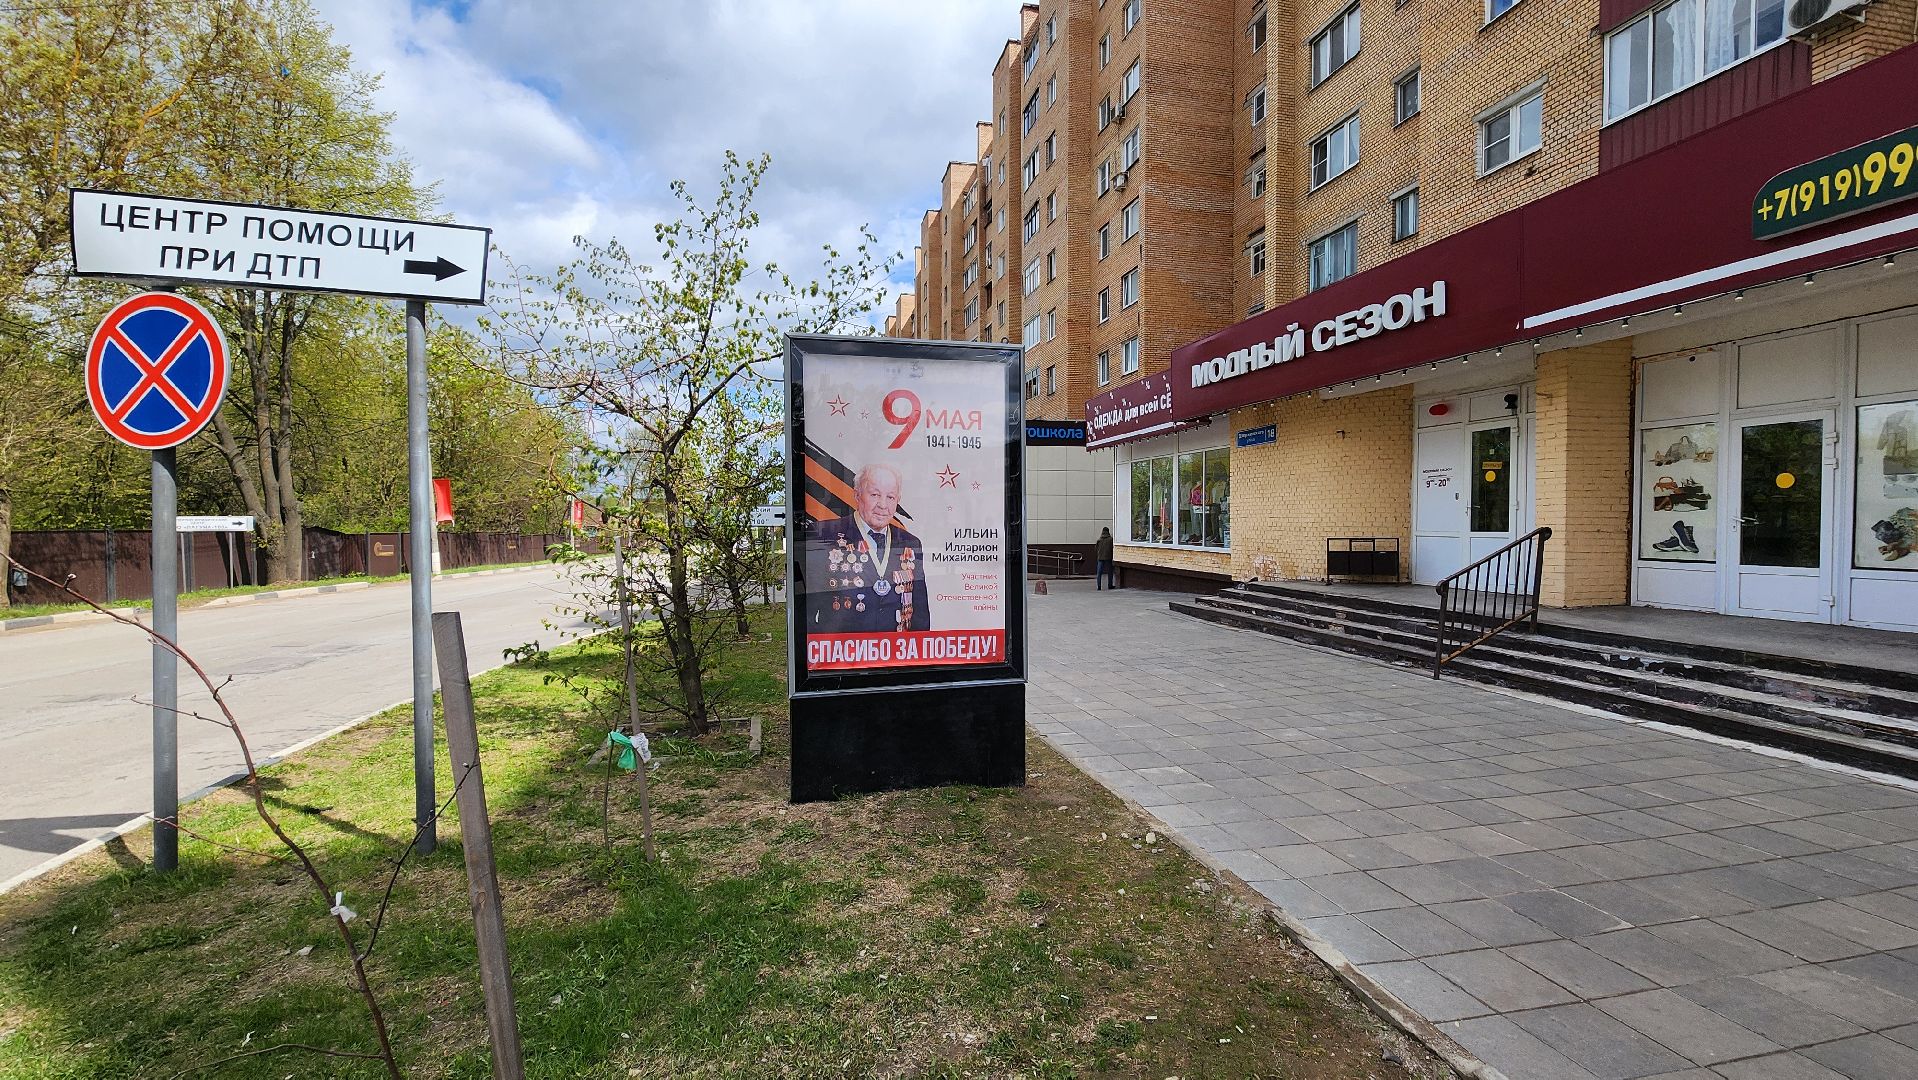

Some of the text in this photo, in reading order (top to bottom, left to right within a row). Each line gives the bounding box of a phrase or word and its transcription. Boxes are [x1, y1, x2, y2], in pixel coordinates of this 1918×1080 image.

[1757, 142, 1918, 221] +7(919)99
[100, 203, 416, 255] ЦЕНТР ПОМОЩИ
[159, 245, 321, 280] ПРИ ДТП
[1191, 280, 1446, 388] МОДНЫЙ СЕЗОН
[882, 388, 983, 450] 9 МАЯ
[1094, 409, 1123, 429] ОДЕЖДА
[1124, 406, 1139, 421] для
[1140, 395, 1159, 415] всей
[926, 434, 982, 449] 1941-1945
[1267, 428, 1275, 438] 18
[954, 528, 998, 539] ИЛЬИН
[931, 552, 998, 562] Михайлович
[945, 542, 998, 553] Илларион
[936, 593, 998, 602] Отечественной
[964, 583, 998, 591] Великой
[808, 635, 997, 664] СПАСИБО ЗА ПОБЕДУ!
